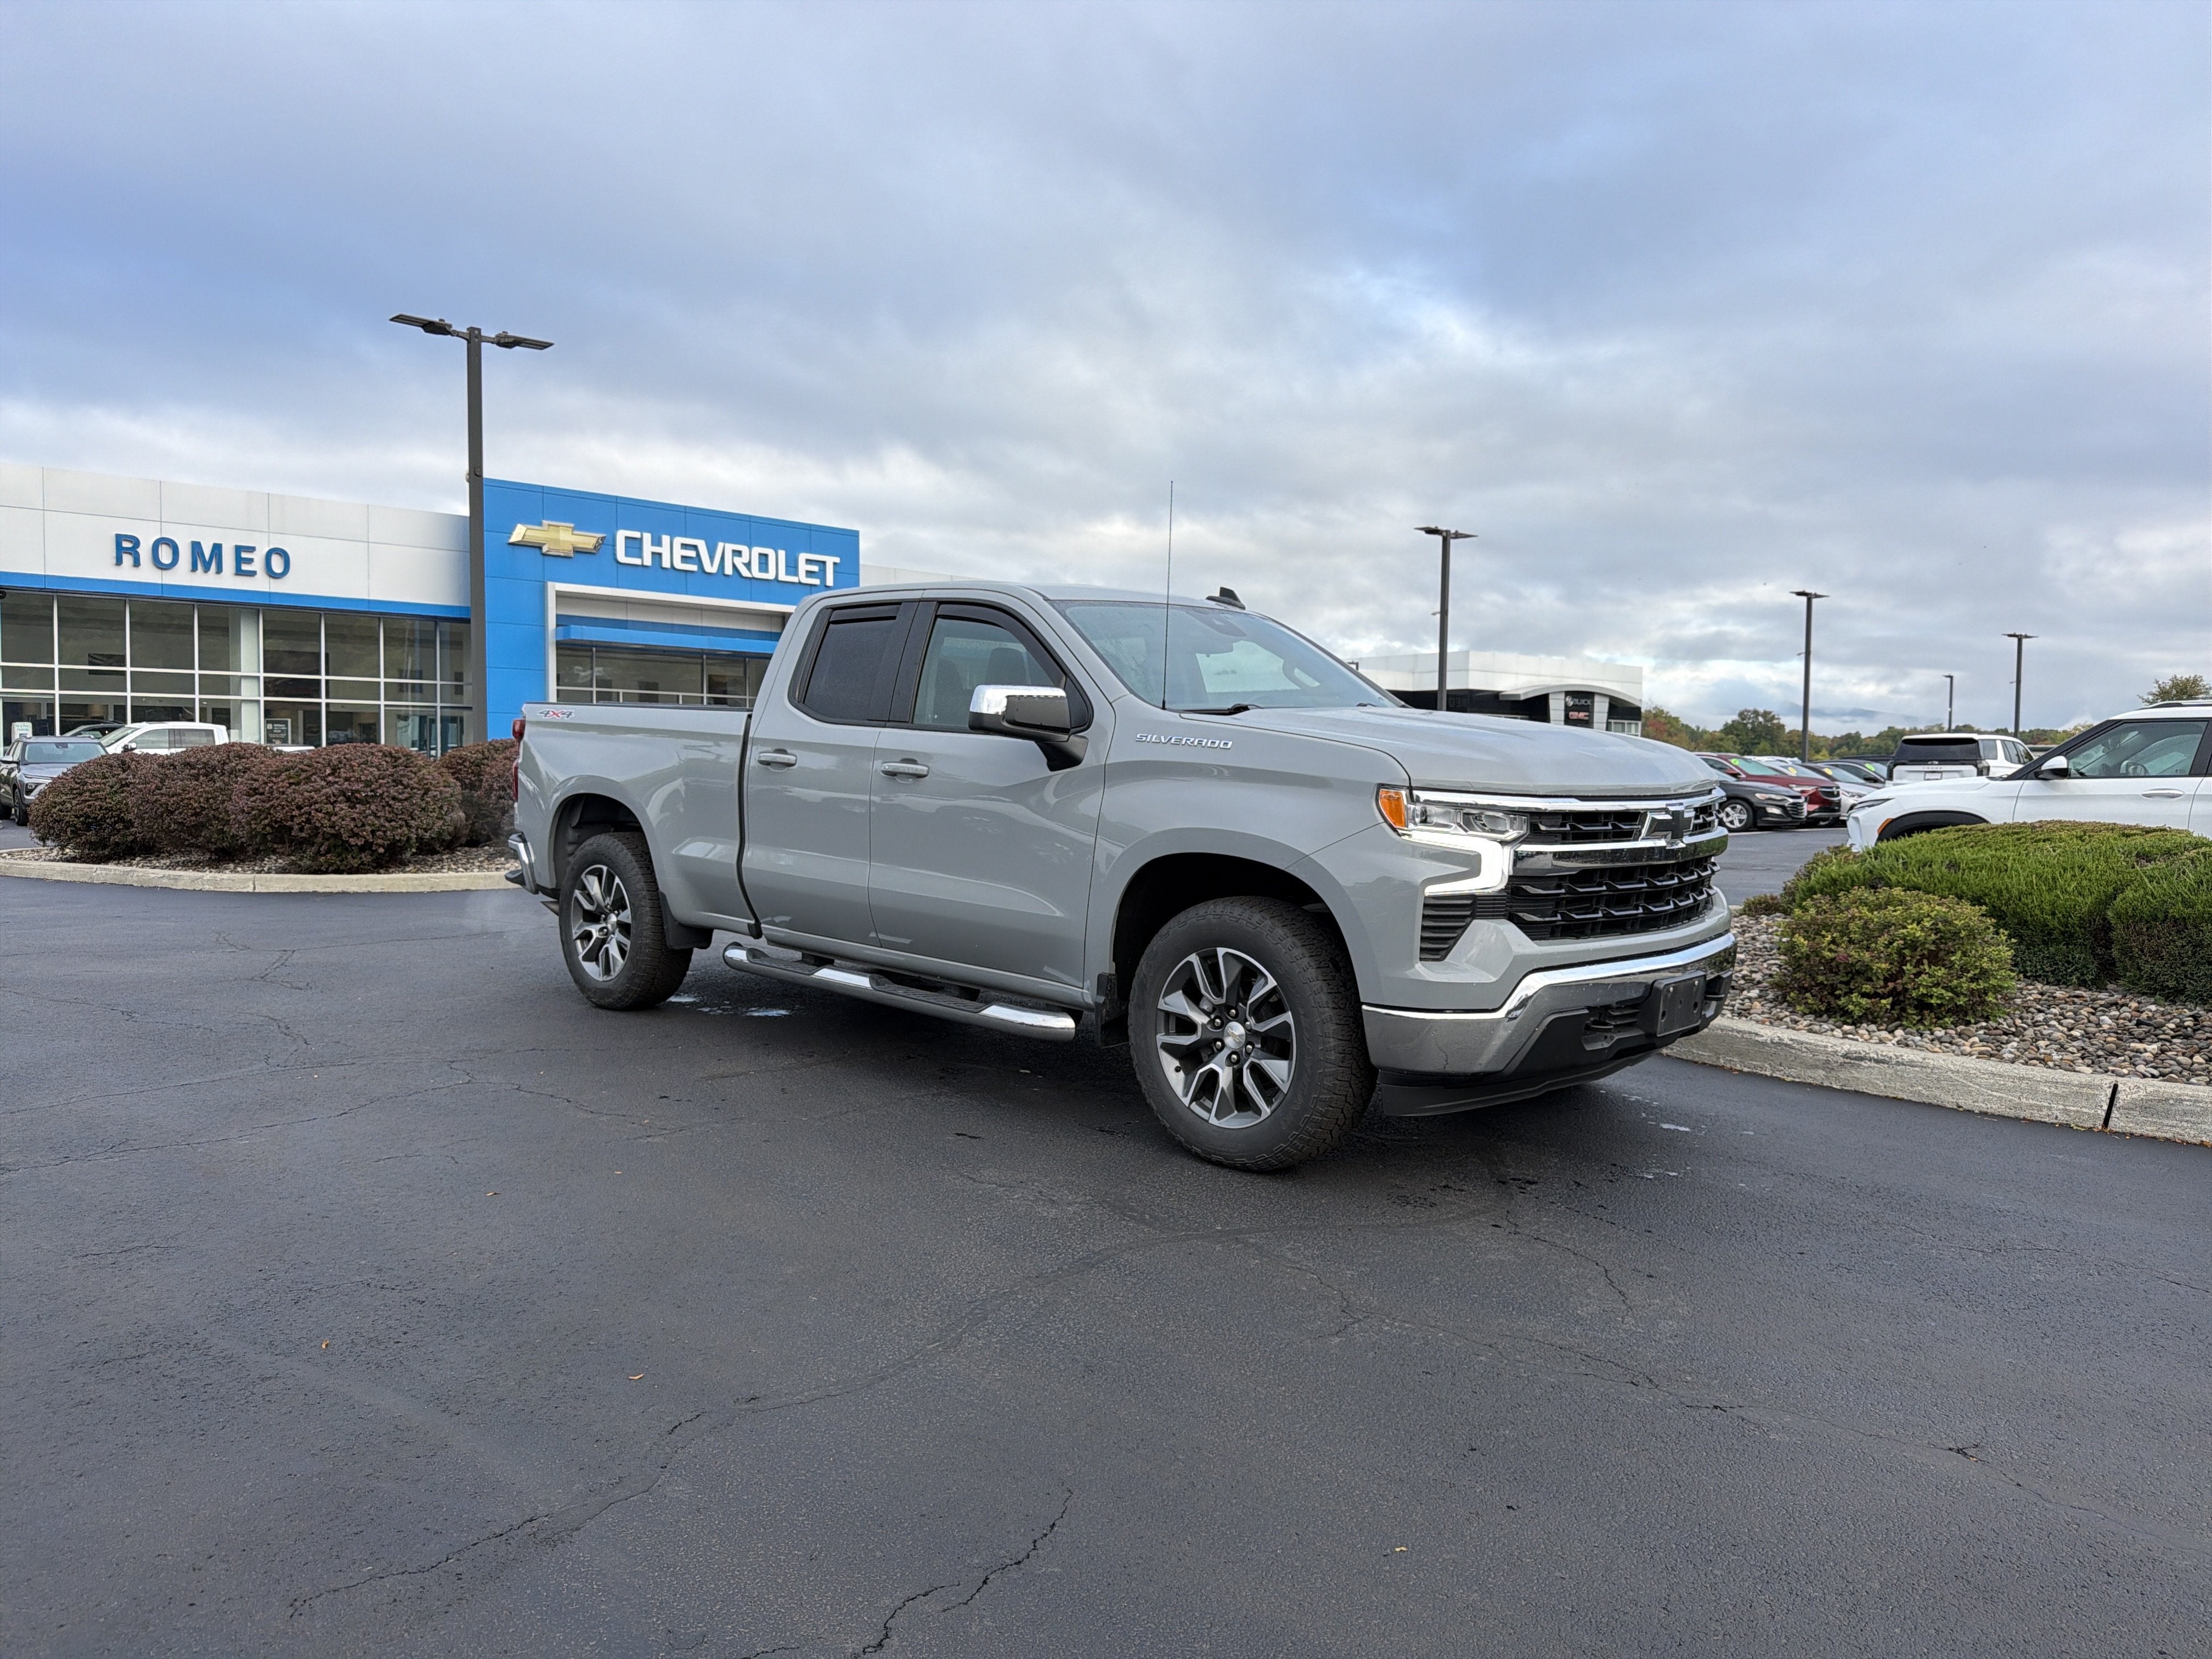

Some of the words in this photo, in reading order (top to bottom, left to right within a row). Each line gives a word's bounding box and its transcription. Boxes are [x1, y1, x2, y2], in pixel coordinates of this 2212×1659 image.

[114, 533, 290, 579] ROMEO
[616, 529, 840, 586] CHEVROLET
[1568, 711, 1589, 720] GMC
[1136, 733, 1233, 749] SILVERADO
